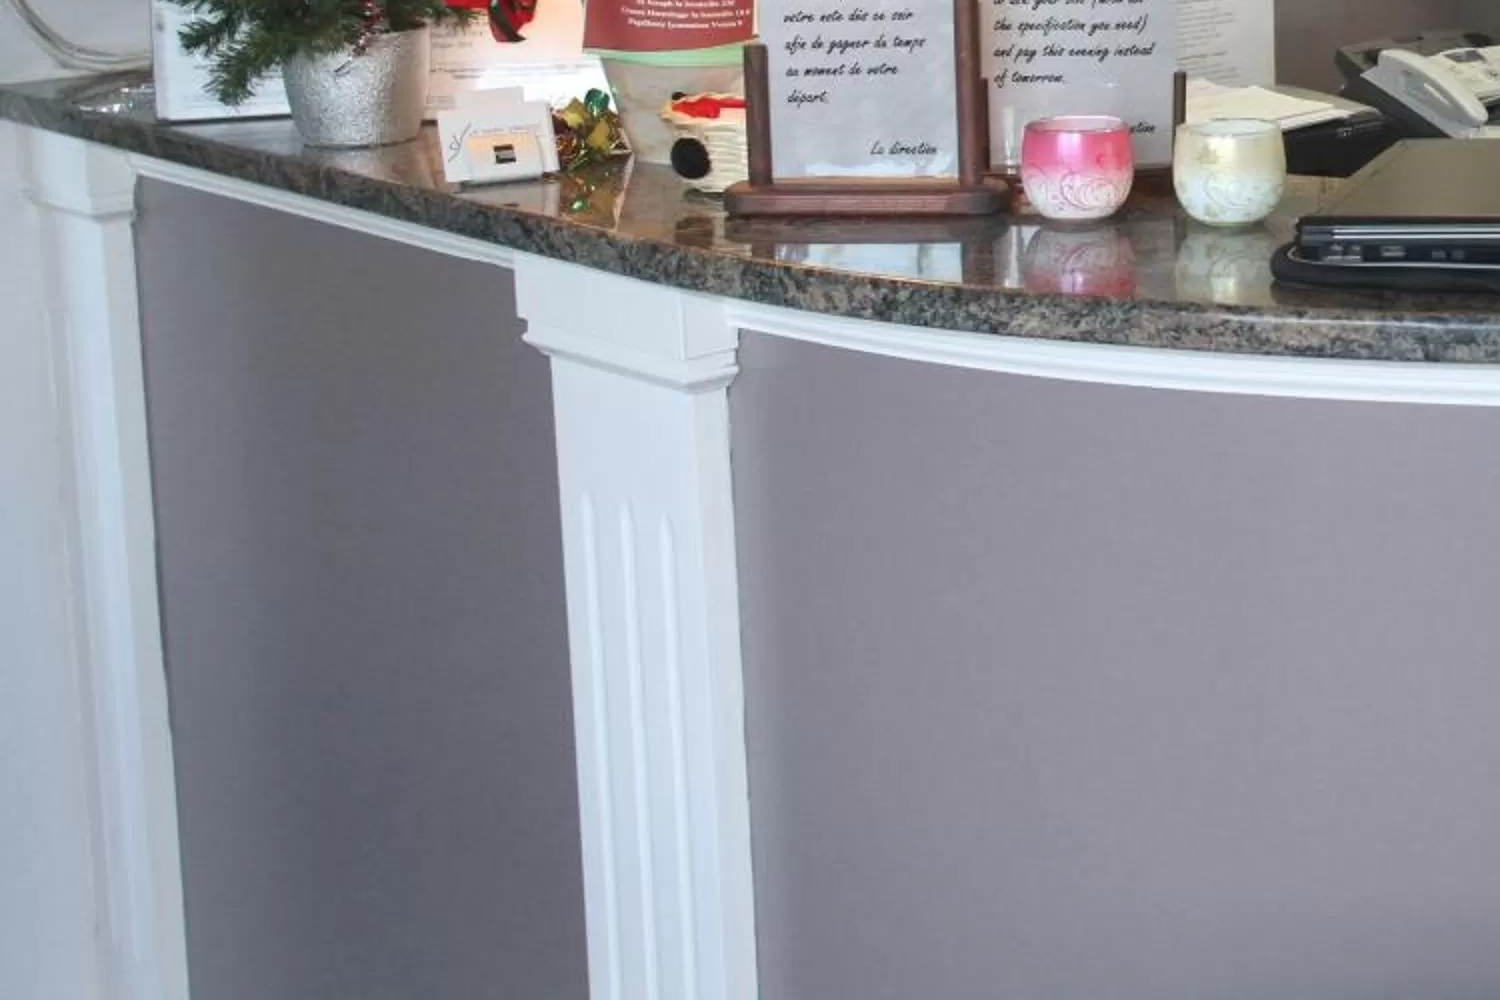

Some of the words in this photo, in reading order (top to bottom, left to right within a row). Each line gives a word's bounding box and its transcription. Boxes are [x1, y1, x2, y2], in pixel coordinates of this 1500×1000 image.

[784, 10, 814, 23] votre
[820, 10, 844, 22] note
[872, 12, 885, 21] ce
[891, 8, 914, 21] soir
[993, 17, 1011, 31] the
[1017, 17, 1085, 36] specification
[1088, 21, 1111, 36] you
[785, 34, 807, 55] afin
[811, 36, 823, 49] de
[827, 39, 870, 54] gagner
[874, 34, 887, 48] du
[893, 36, 926, 53] temps
[993, 44, 1015, 57] and
[1014, 48, 1037, 63] pay
[1042, 44, 1065, 57] this
[1068, 48, 1109, 63] evening
[1114, 42, 1156, 57] instead
[786, 67, 799, 77] au
[804, 64, 846, 77] moment
[848, 61, 861, 75] de
[867, 63, 898, 75] votre
[993, 68, 1008, 88] of
[869, 139, 885, 155] La
[888, 140, 938, 155] direction
